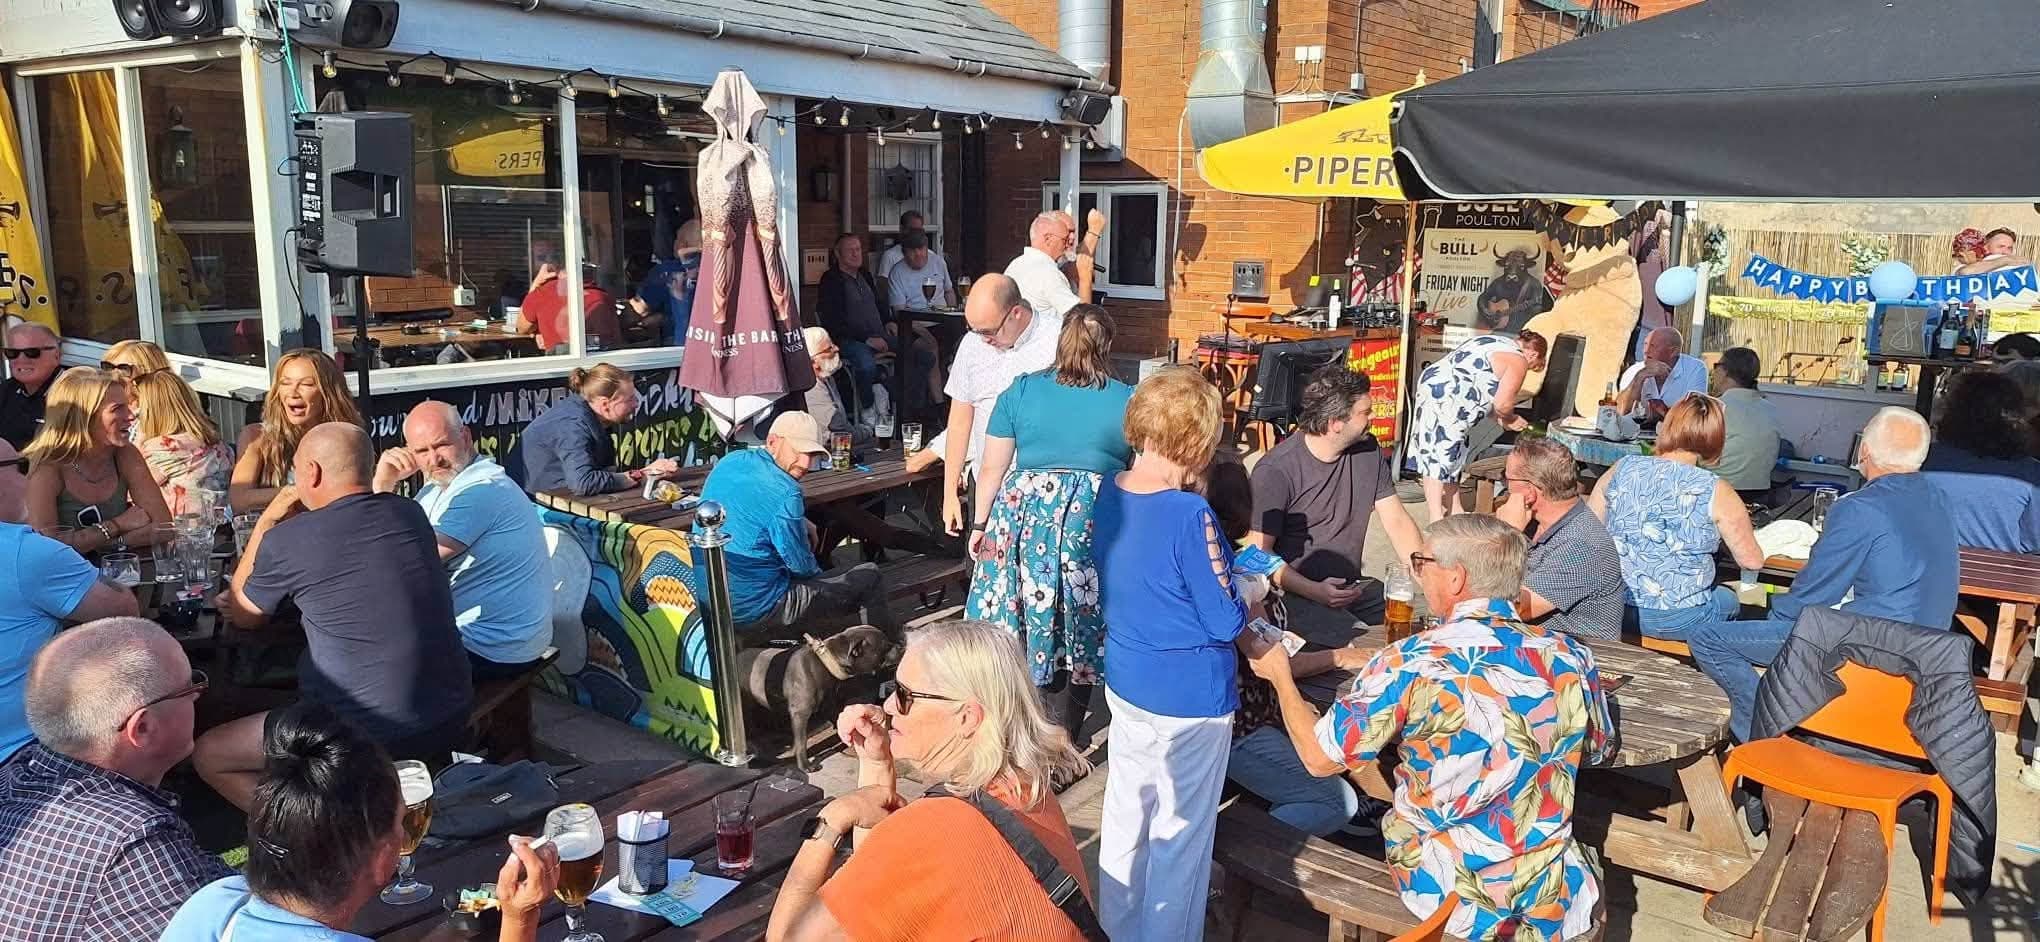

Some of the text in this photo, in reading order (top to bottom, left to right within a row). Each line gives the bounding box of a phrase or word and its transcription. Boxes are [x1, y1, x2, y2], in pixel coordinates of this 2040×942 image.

[1293, 156, 1394, 186] PIPER
[1455, 214, 1520, 227] POULTON
[1440, 242, 1478, 256] BULL
[1426, 274, 1490, 293] FRIDAY NIGHT
[1750, 259, 2029, 297] HAPPY BTHDAY
[722, 333, 746, 347] THE
[751, 329, 778, 343] BAR
